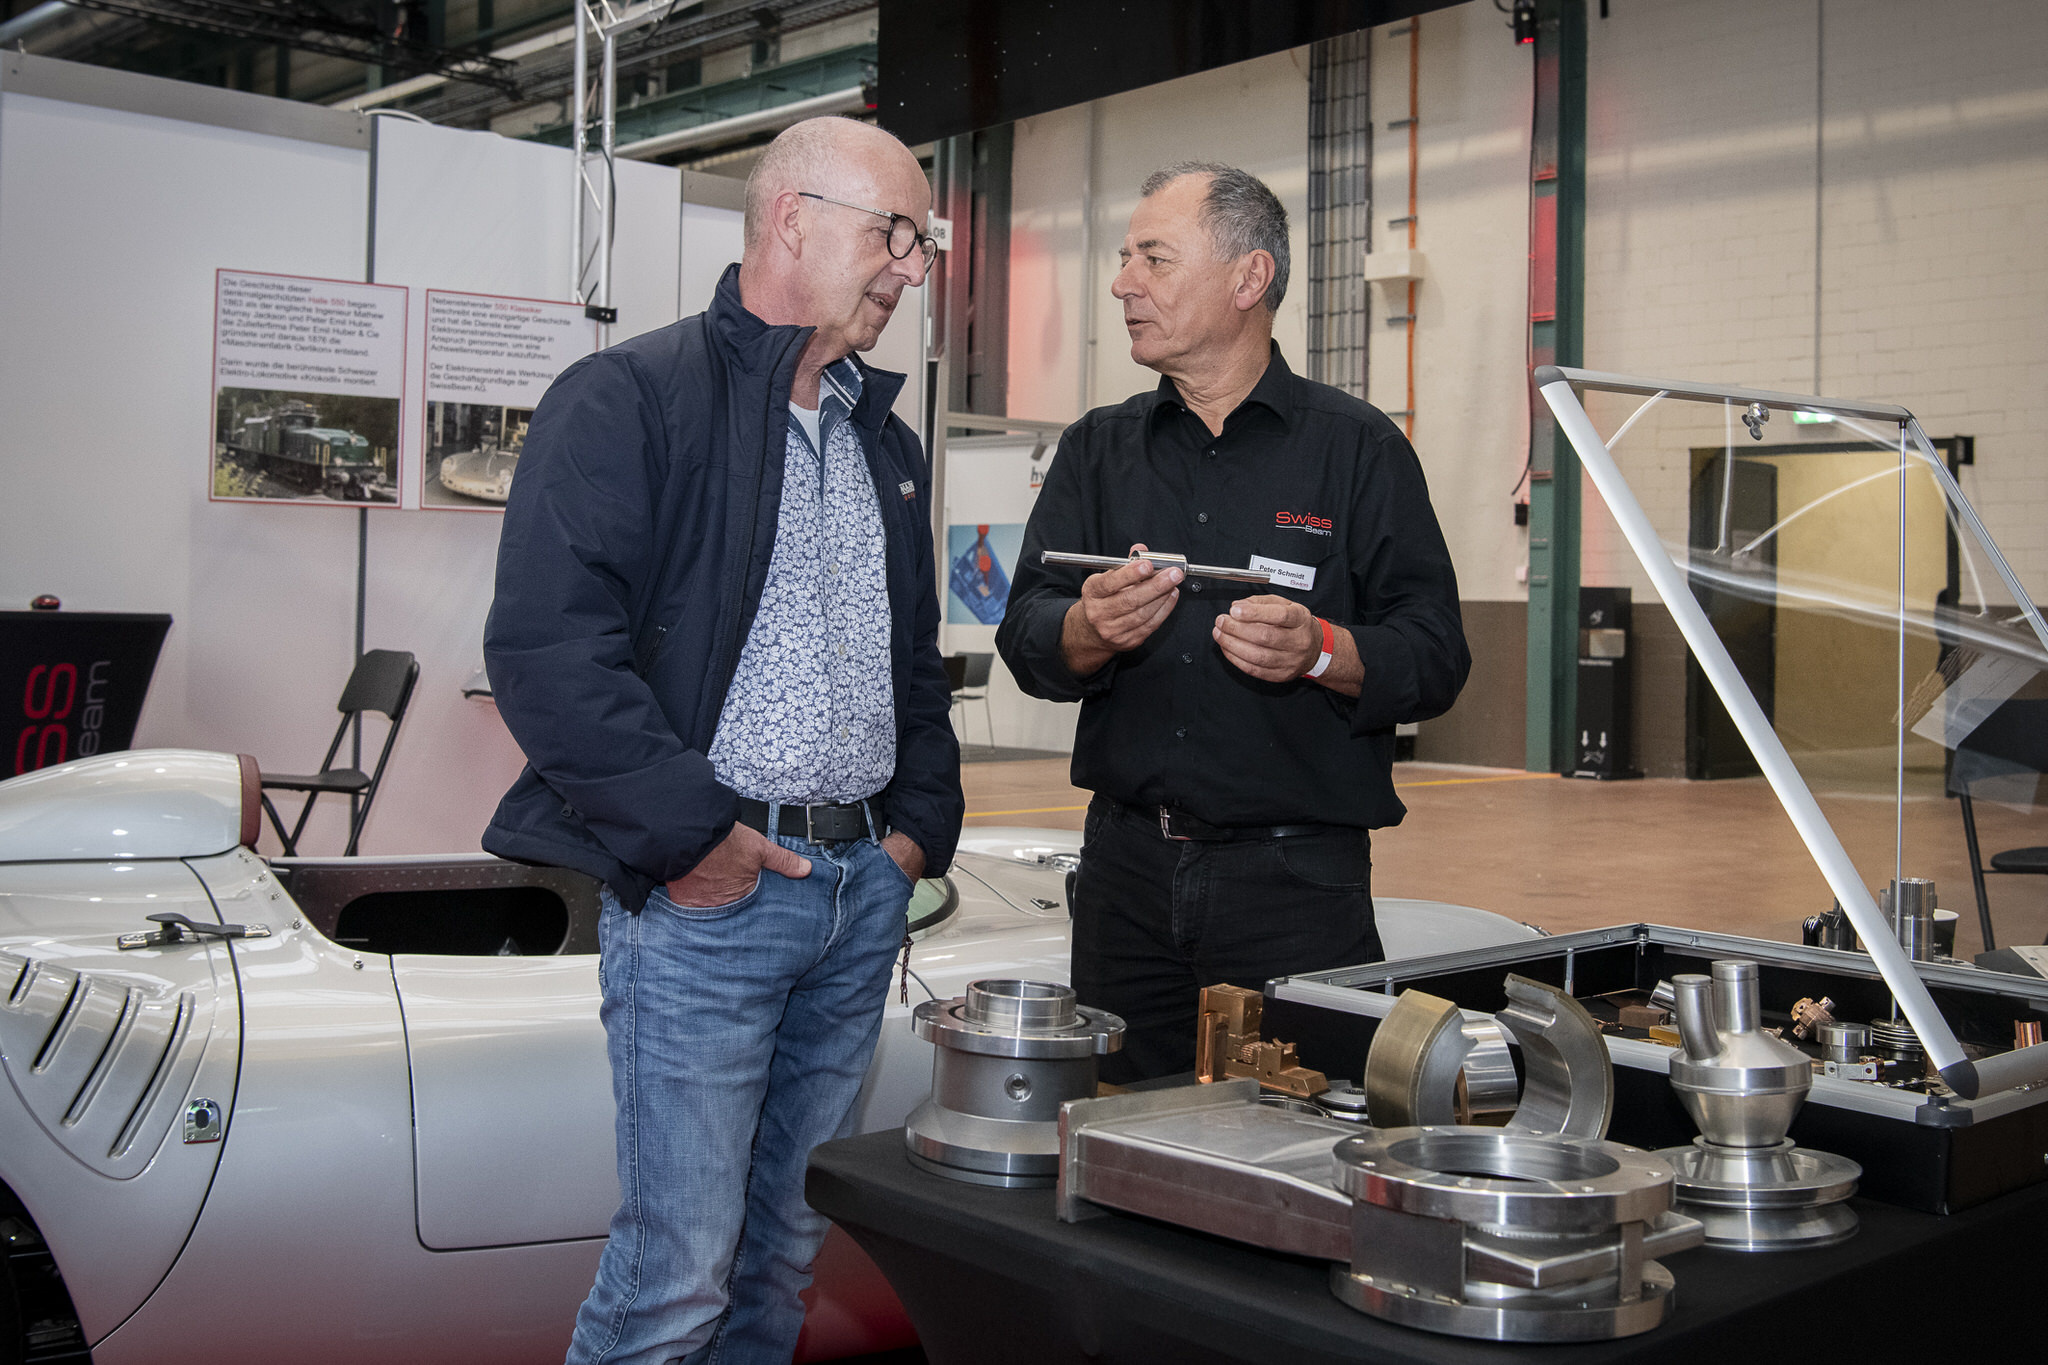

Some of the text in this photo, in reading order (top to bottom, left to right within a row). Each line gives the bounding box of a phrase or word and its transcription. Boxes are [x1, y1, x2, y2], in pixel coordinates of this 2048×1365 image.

[1031, 466, 1047, 484] hy
[1275, 511, 1333, 529] Swiss
[1305, 525, 1332, 537] Beam
[1259, 564, 1305, 580] Peter Schmidt
[78, 660, 111, 757] eam
